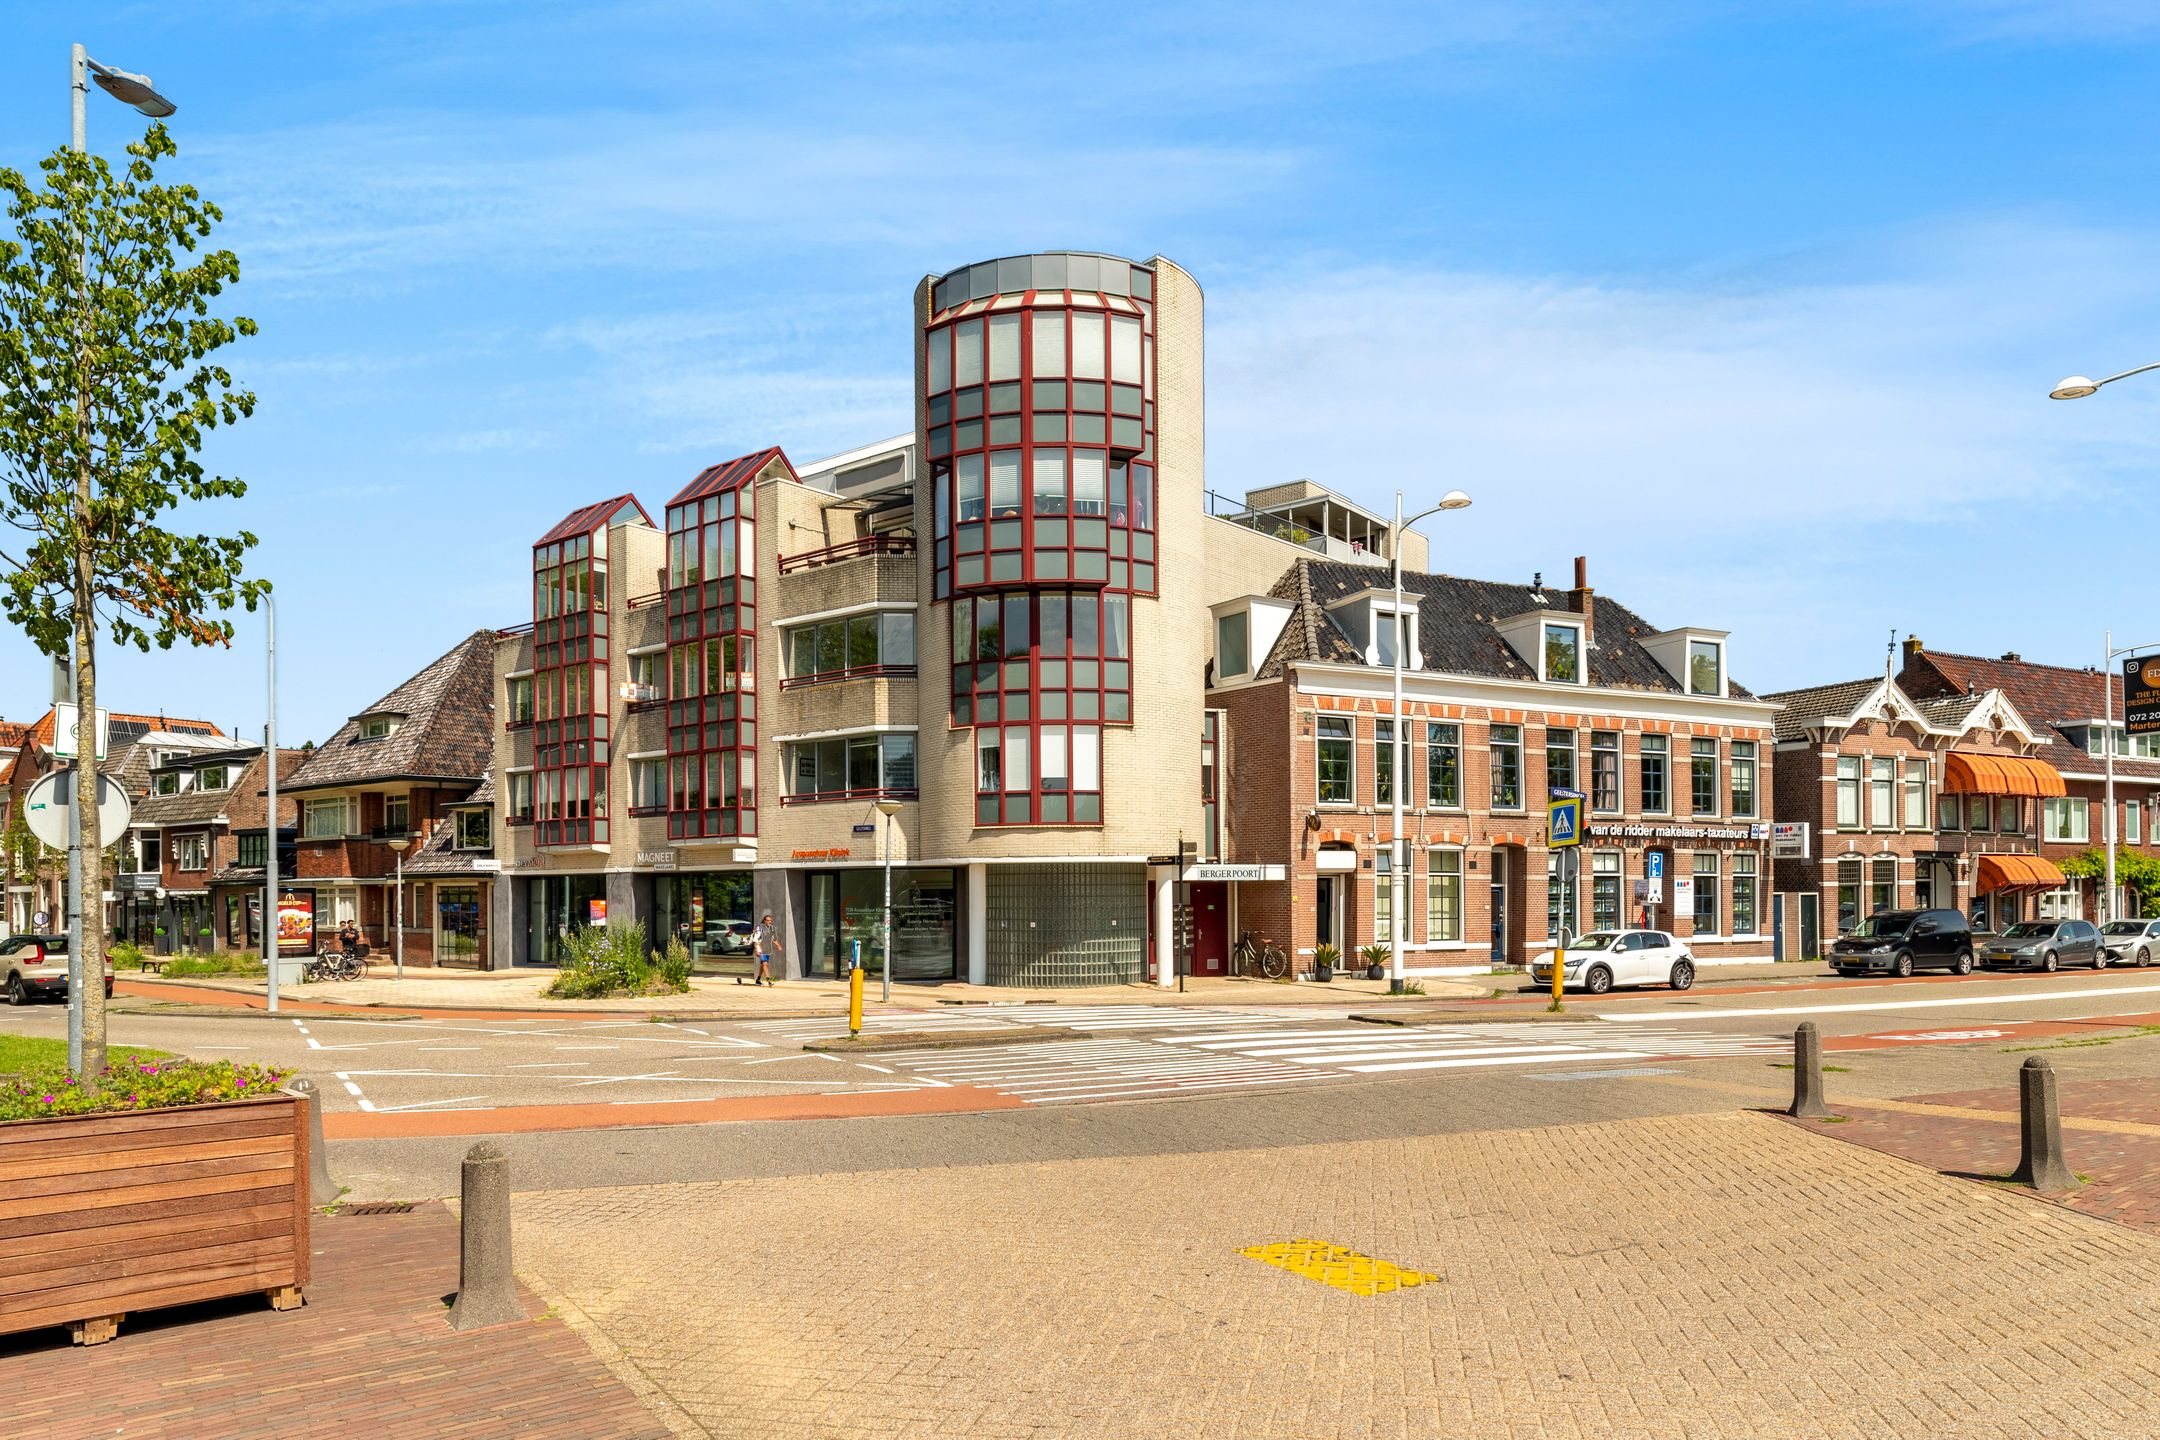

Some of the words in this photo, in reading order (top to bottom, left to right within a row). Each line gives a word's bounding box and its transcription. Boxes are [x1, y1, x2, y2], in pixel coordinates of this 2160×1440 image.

[2136, 691, 2151, 699] THE
[2127, 697, 2155, 706] DESIGN
[2129, 713, 2147, 721] 072
[2149, 711, 2160, 720] 20
[1590, 826, 1608, 835] van
[1610, 824, 1622, 835] de
[1625, 824, 1654, 836] ridder
[637, 851, 674, 862] MAGNEET
[1200, 869, 1258, 878] BERGERPOORT
